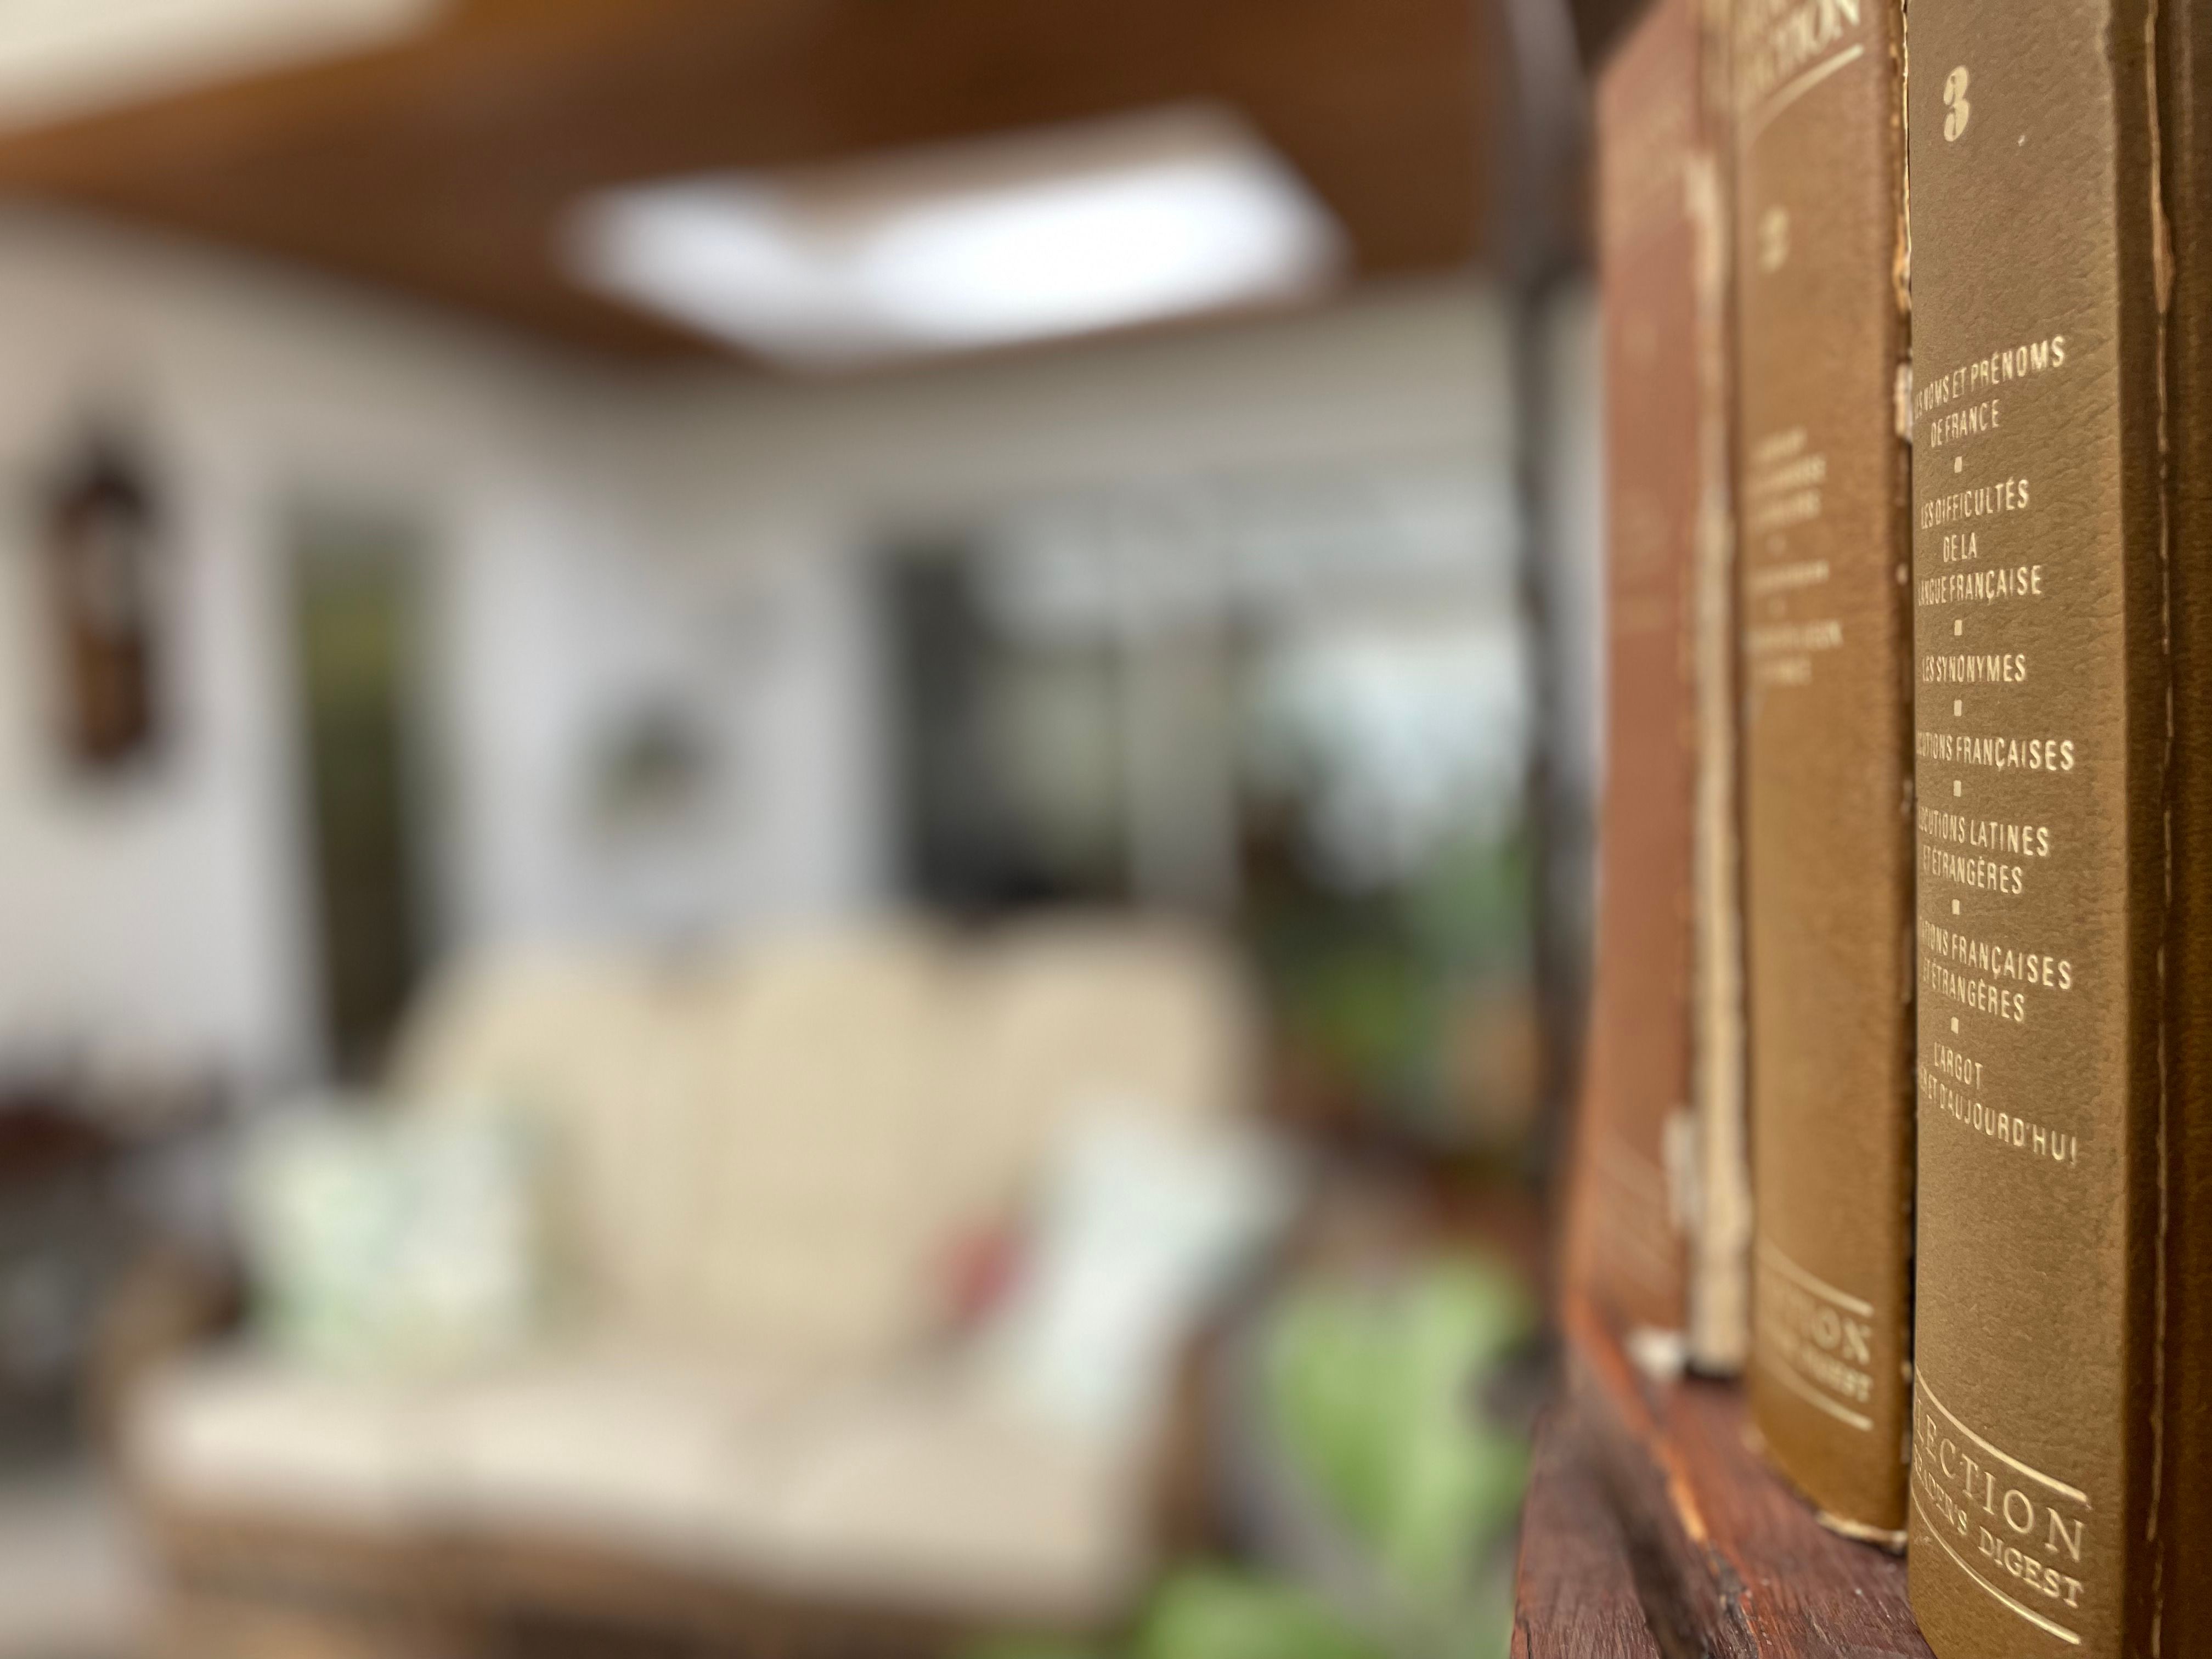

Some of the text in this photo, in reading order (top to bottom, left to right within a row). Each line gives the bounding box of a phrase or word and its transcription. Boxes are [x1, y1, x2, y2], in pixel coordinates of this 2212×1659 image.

[1944, 65, 1970, 142] 3
[1923, 375, 1949, 412] NOMS
[1952, 367, 1967, 399] ET
[1971, 336, 2066, 392] PRÉNOMS
[1931, 399, 2000, 448] DE FRANCE
[1921, 477, 2029, 529] LES DIFFICULTÉS
[1943, 532, 1978, 563] DE LA
[1949, 565, 2042, 606] FRANÇAISE
[1922, 653, 2026, 682] LES SYNONYMES
[1956, 735, 2075, 772] FRANÇAISES
[1970, 819, 2050, 857] LATINES
[1923, 845, 2023, 895] ET ÉTRANGÈRES
[1951, 933, 2072, 990] FRANÇAISES
[1923, 957, 2025, 1023] ET ÉTRANGÈRES
[1928, 1074, 1938, 1104] ET
[1934, 1041, 1983, 1090] L'ARGOT
[1978, 1525, 2084, 1609] DIGEST
